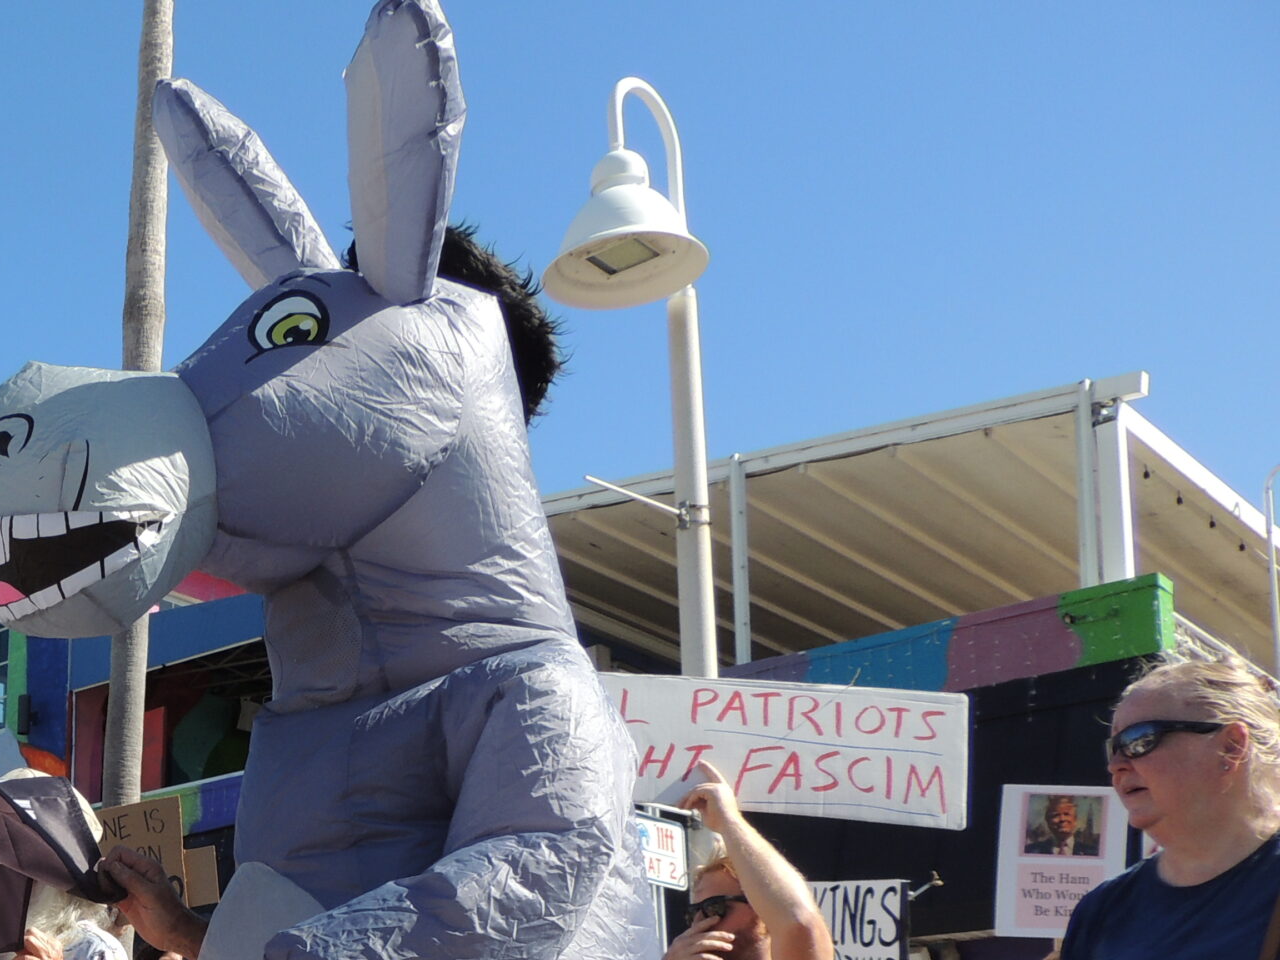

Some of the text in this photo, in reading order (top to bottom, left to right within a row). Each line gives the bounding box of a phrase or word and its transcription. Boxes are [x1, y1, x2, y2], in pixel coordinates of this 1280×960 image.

[690, 688, 946, 741] PATRIOTS
[734, 745, 946, 814] FASCIM
[99, 807, 165, 843] NE IS
[669, 861, 677, 880] 2
[1031, 872, 1090, 884] The Ham
[1022, 888, 1052, 901] Who
[1034, 905, 1050, 916] Be
